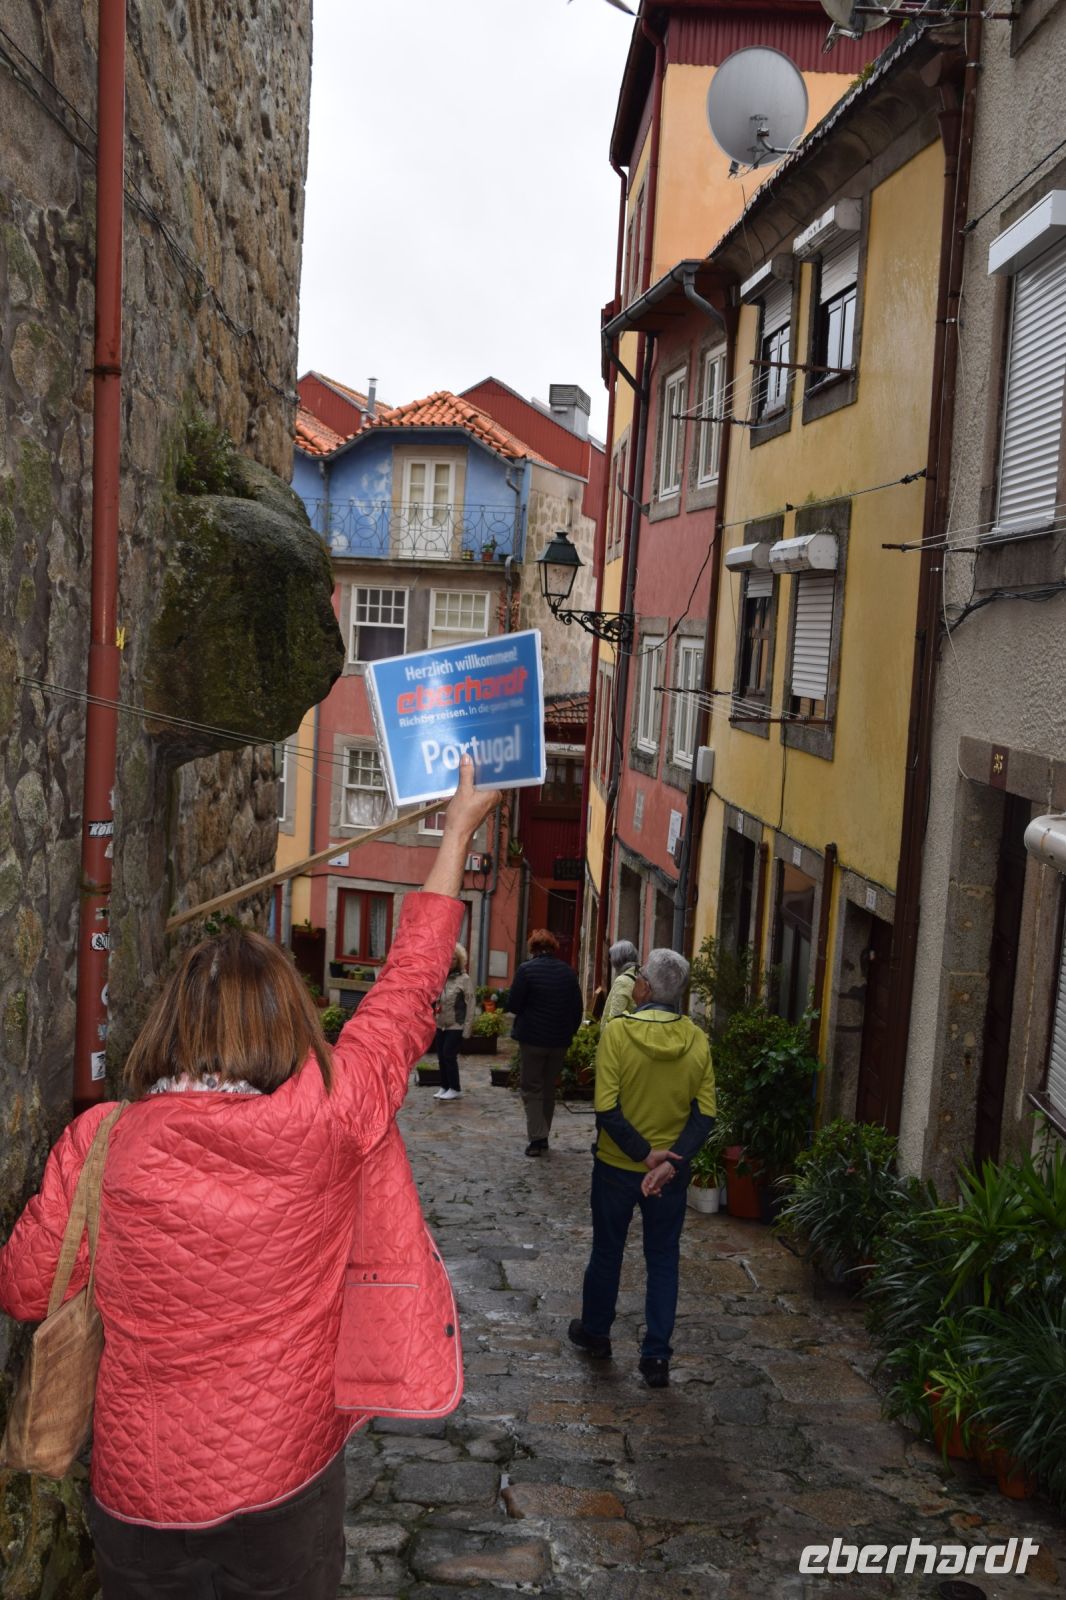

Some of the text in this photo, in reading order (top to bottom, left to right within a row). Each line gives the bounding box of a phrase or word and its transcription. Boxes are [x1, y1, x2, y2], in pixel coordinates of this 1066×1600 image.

[405, 646, 518, 680] Herzlich willkommen!
[397, 665, 528, 714] eberhardt
[436, 707, 468, 721] reisen.
[469, 706, 477, 716] In
[421, 724, 521, 774] Portugal
